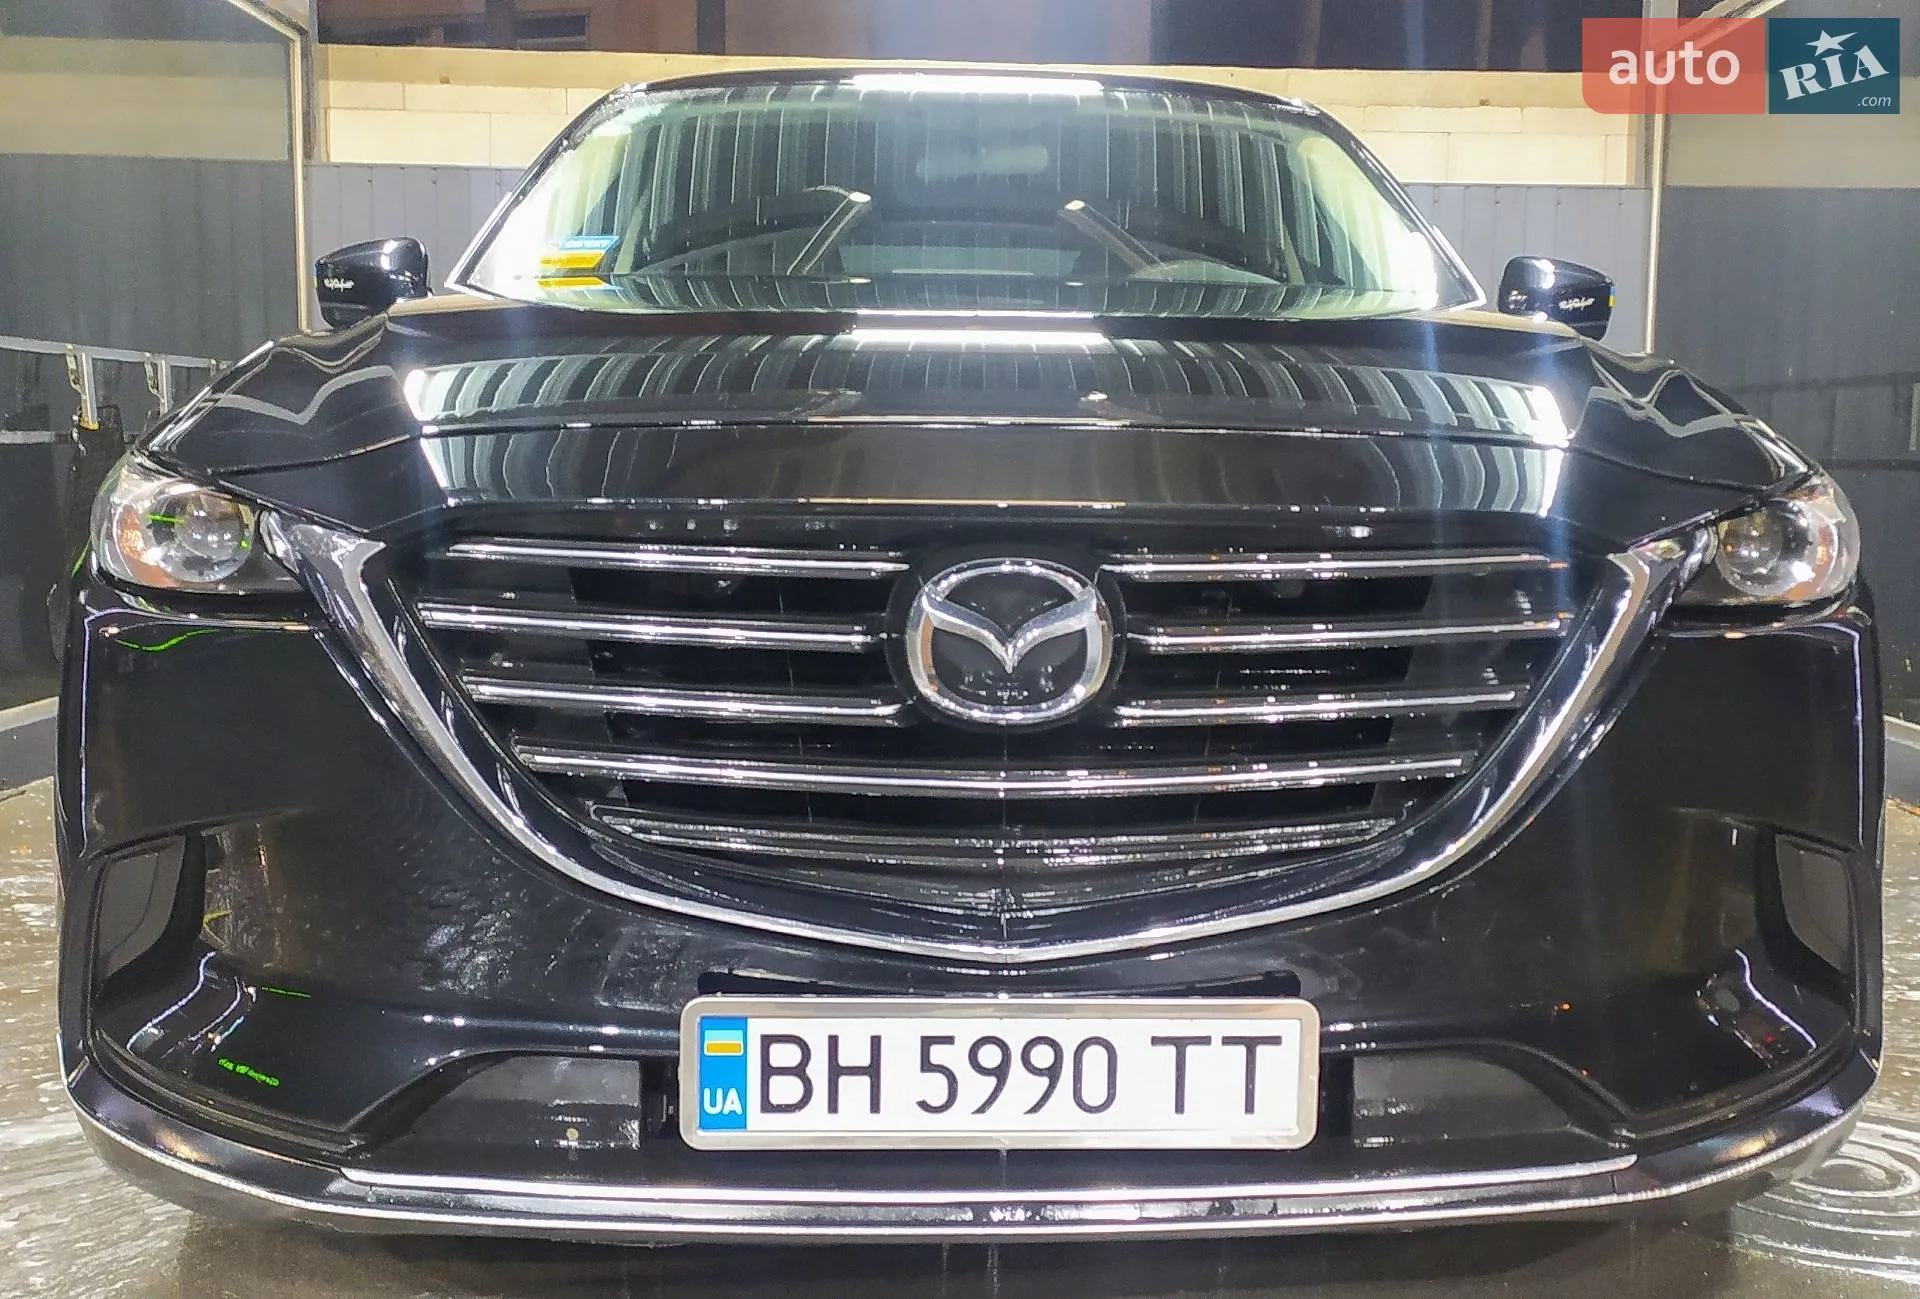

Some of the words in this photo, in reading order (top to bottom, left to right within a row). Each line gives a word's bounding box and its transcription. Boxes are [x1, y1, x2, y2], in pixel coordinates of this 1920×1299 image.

[760, 1034, 882, 1114] BH
[916, 1035, 1117, 1114] 5990
[1150, 1035, 1282, 1114] TT
[703, 1087, 743, 1116] UA
